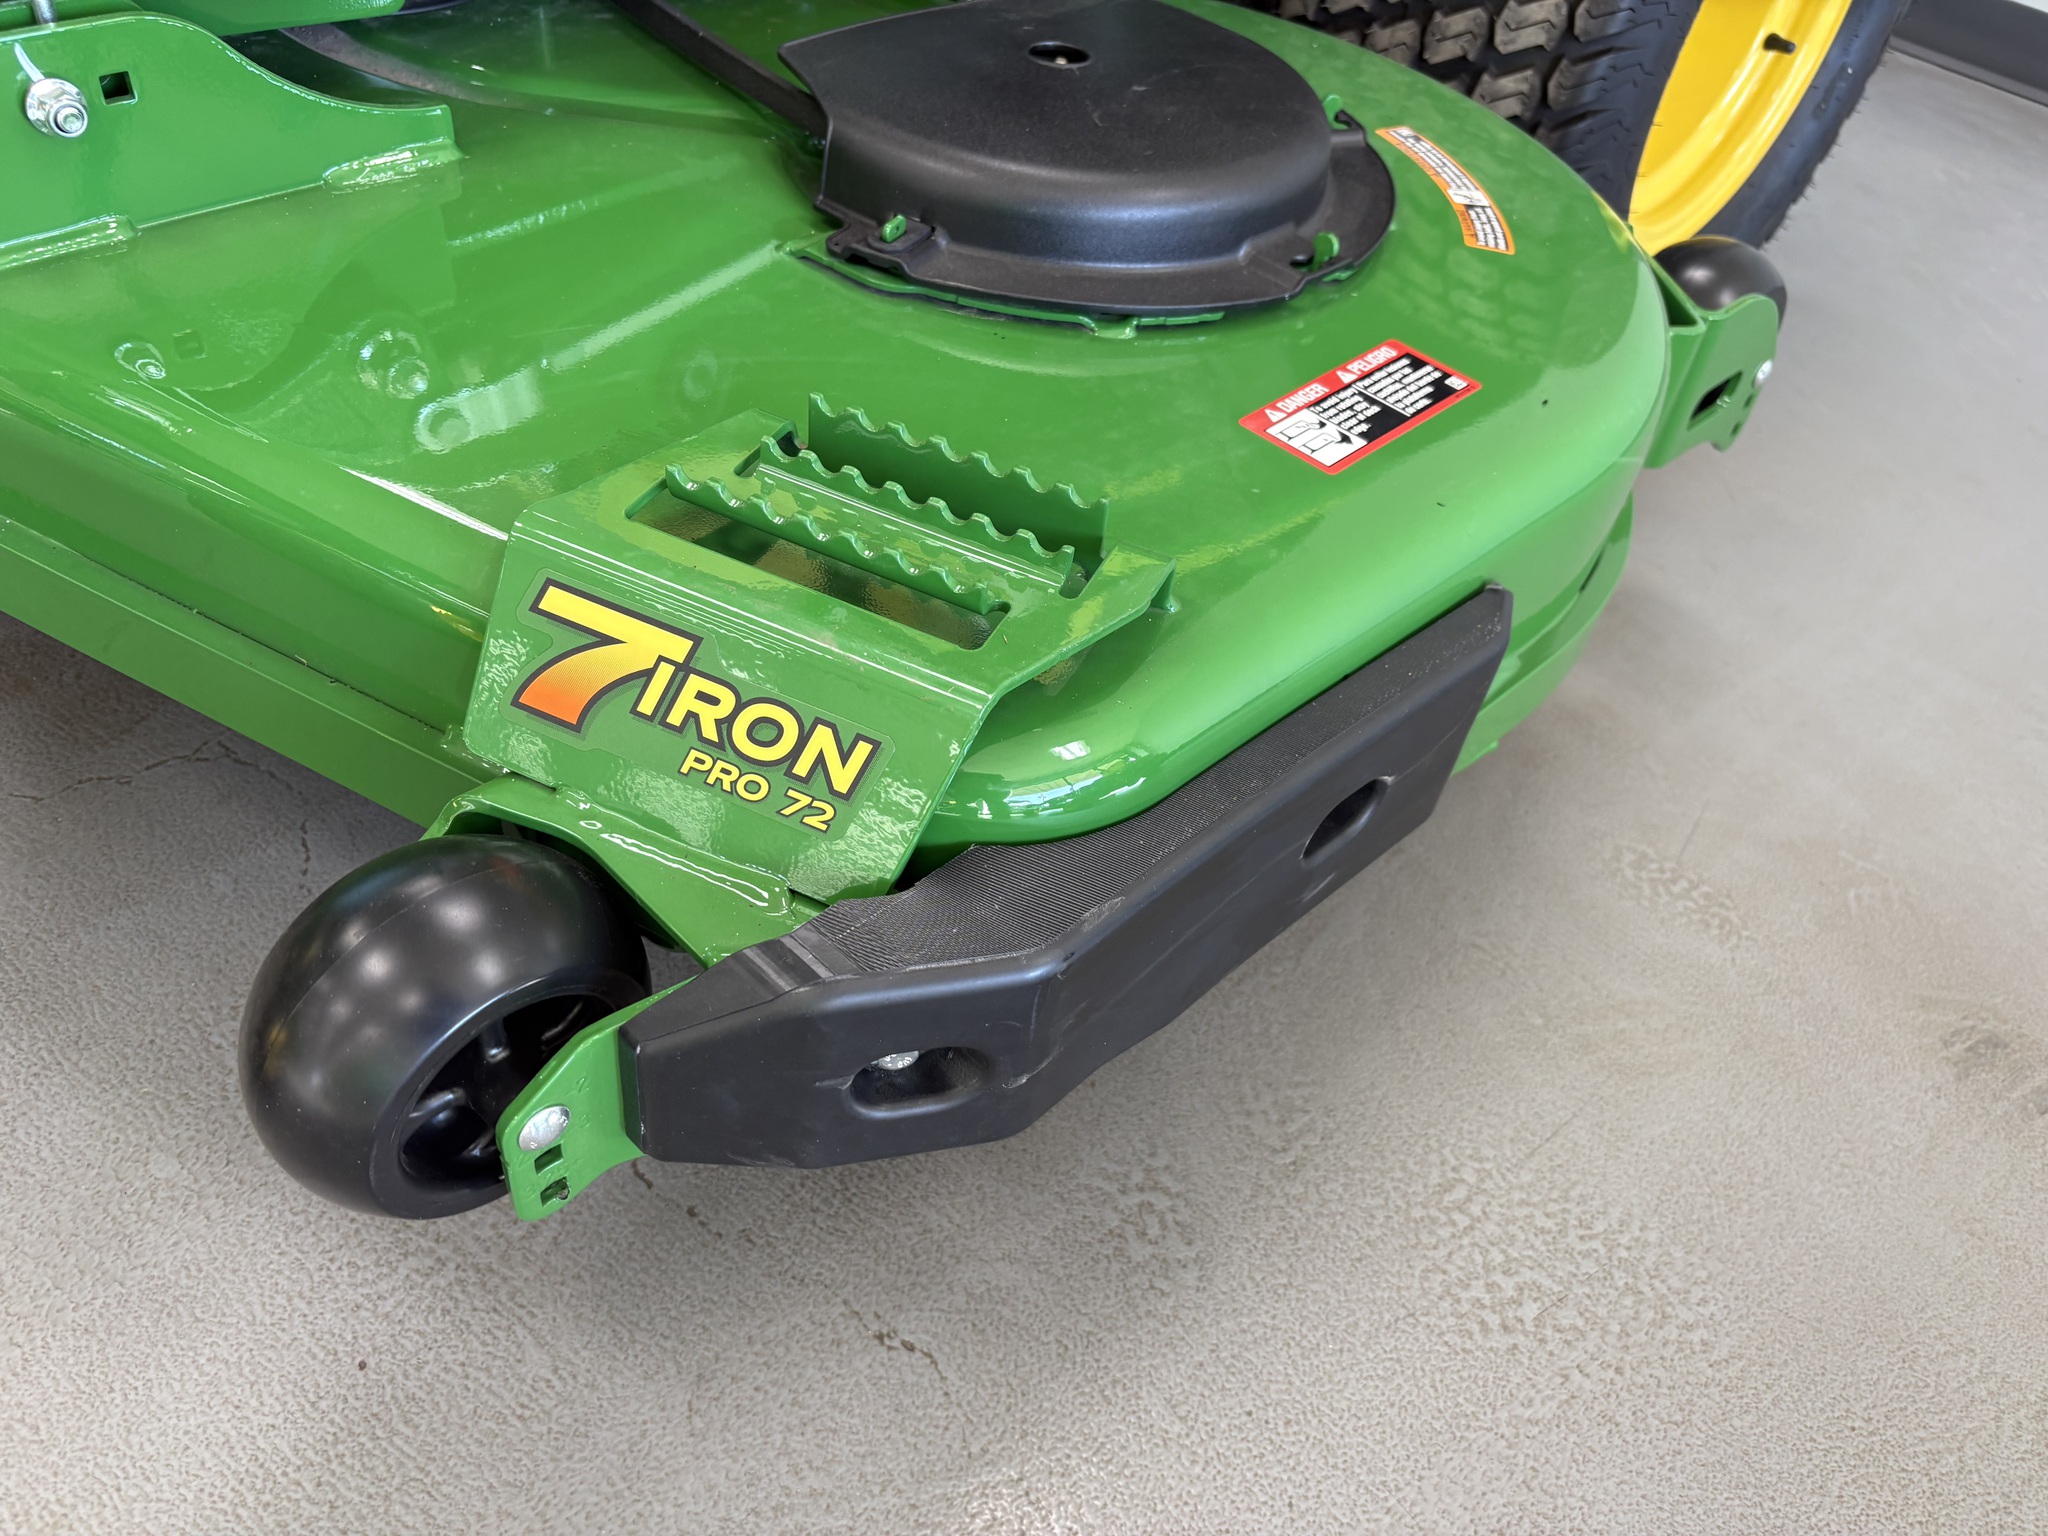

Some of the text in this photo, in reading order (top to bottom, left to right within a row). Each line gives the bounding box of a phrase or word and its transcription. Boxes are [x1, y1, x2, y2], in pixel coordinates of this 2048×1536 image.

[1346, 346, 1397, 375] PELIGRO
[1276, 383, 1329, 413] DANGER
[1319, 395, 1340, 409] avoid
[630, 655, 882, 800] IRON
[678, 747, 837, 834] PRO 72
